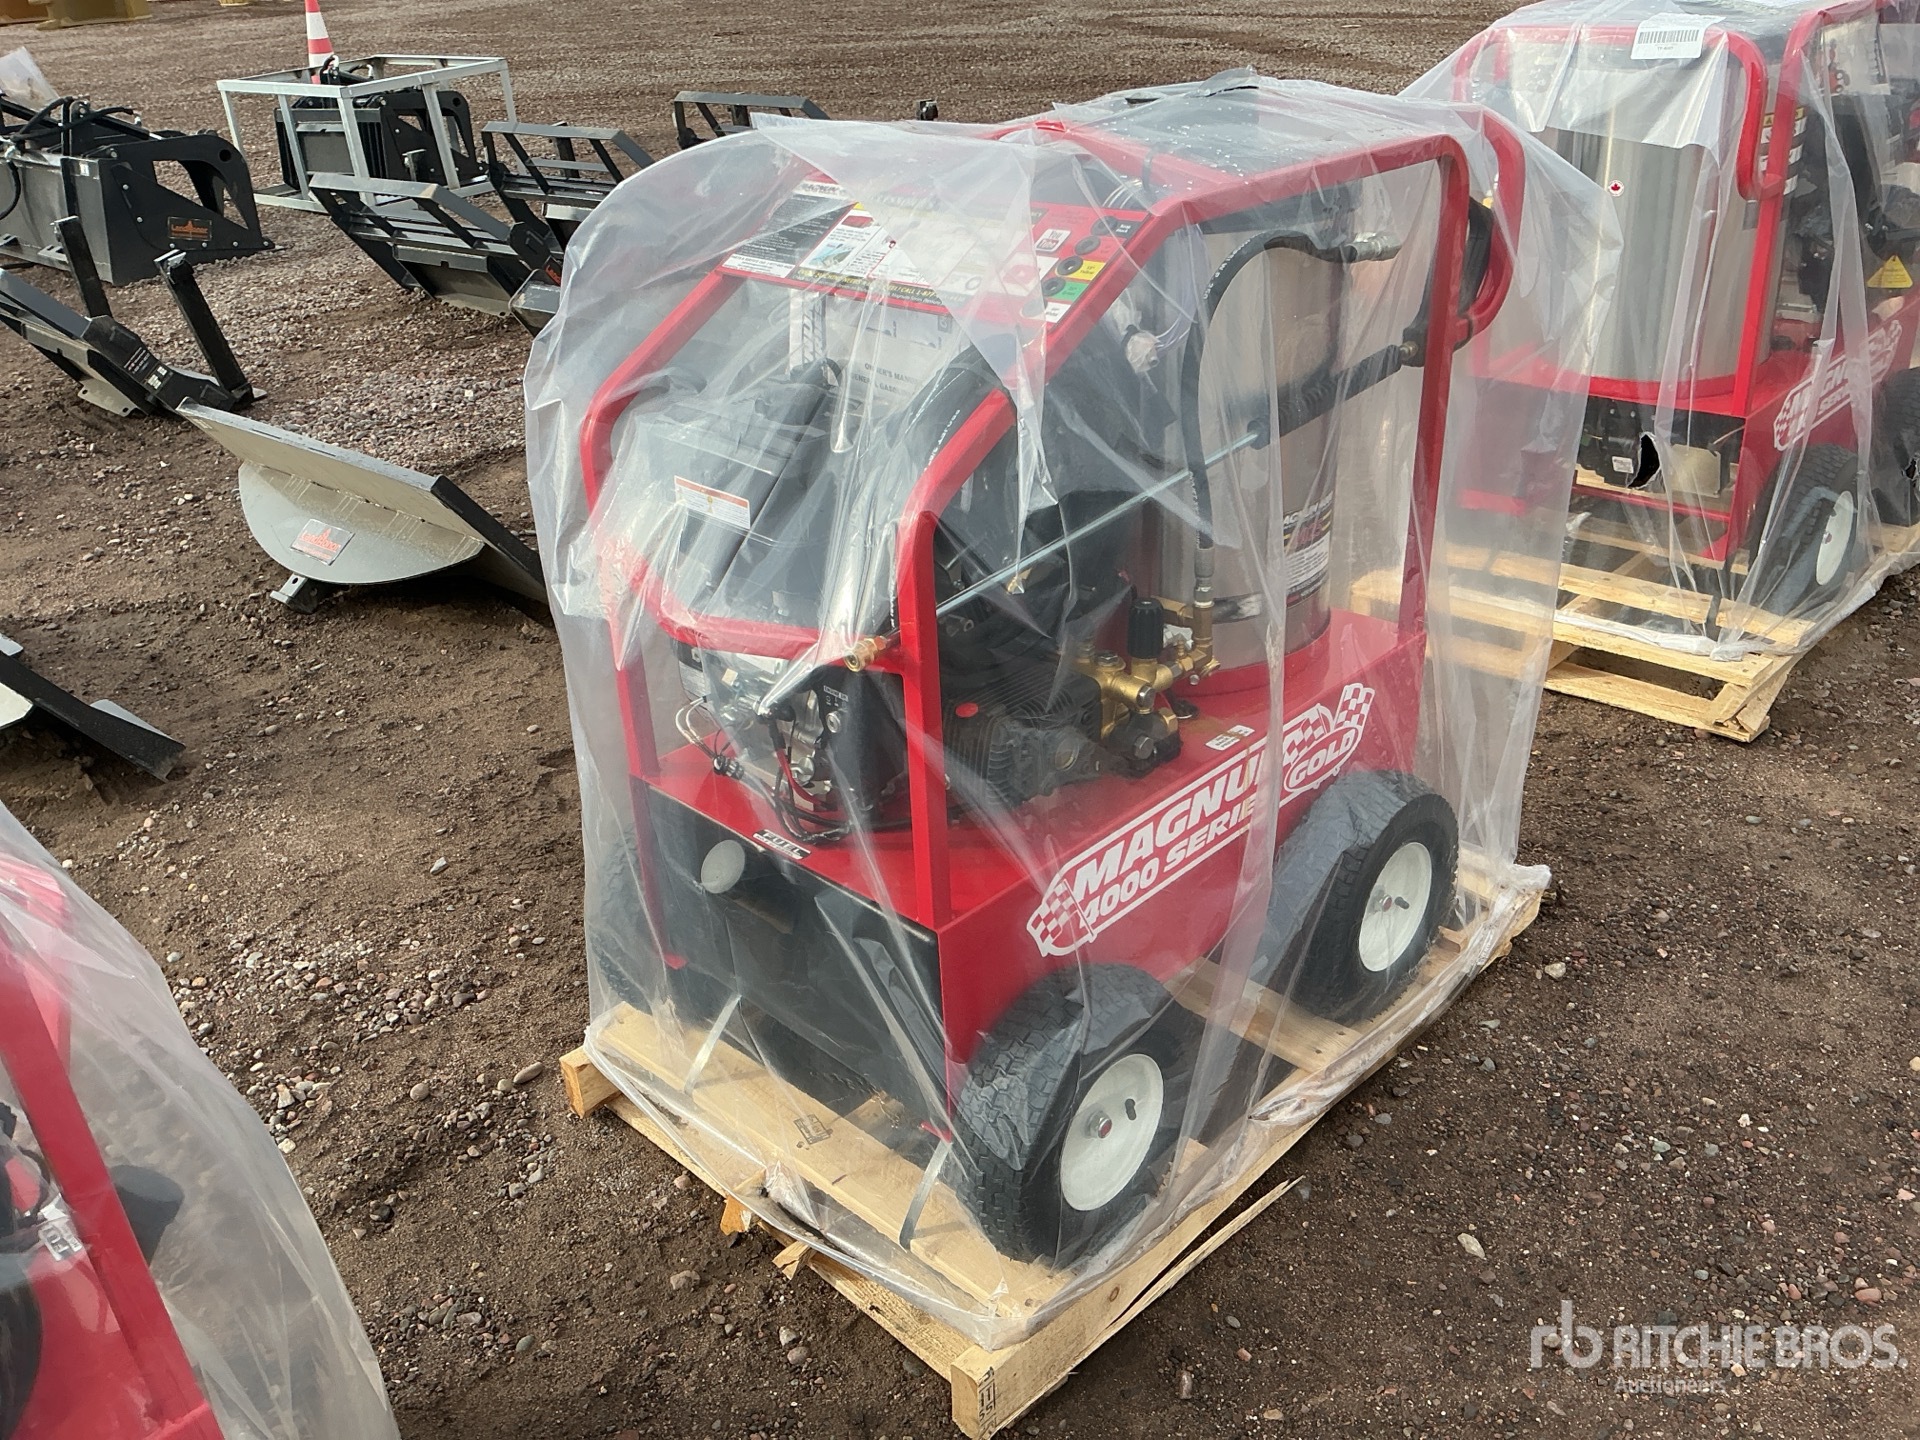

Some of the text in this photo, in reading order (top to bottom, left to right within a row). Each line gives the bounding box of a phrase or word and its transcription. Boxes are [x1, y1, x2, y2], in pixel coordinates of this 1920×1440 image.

[1287, 730, 1352, 789] GOLD
[762, 831, 802, 857] FUEL
[1079, 798, 1259, 928] 4000 SERIE
